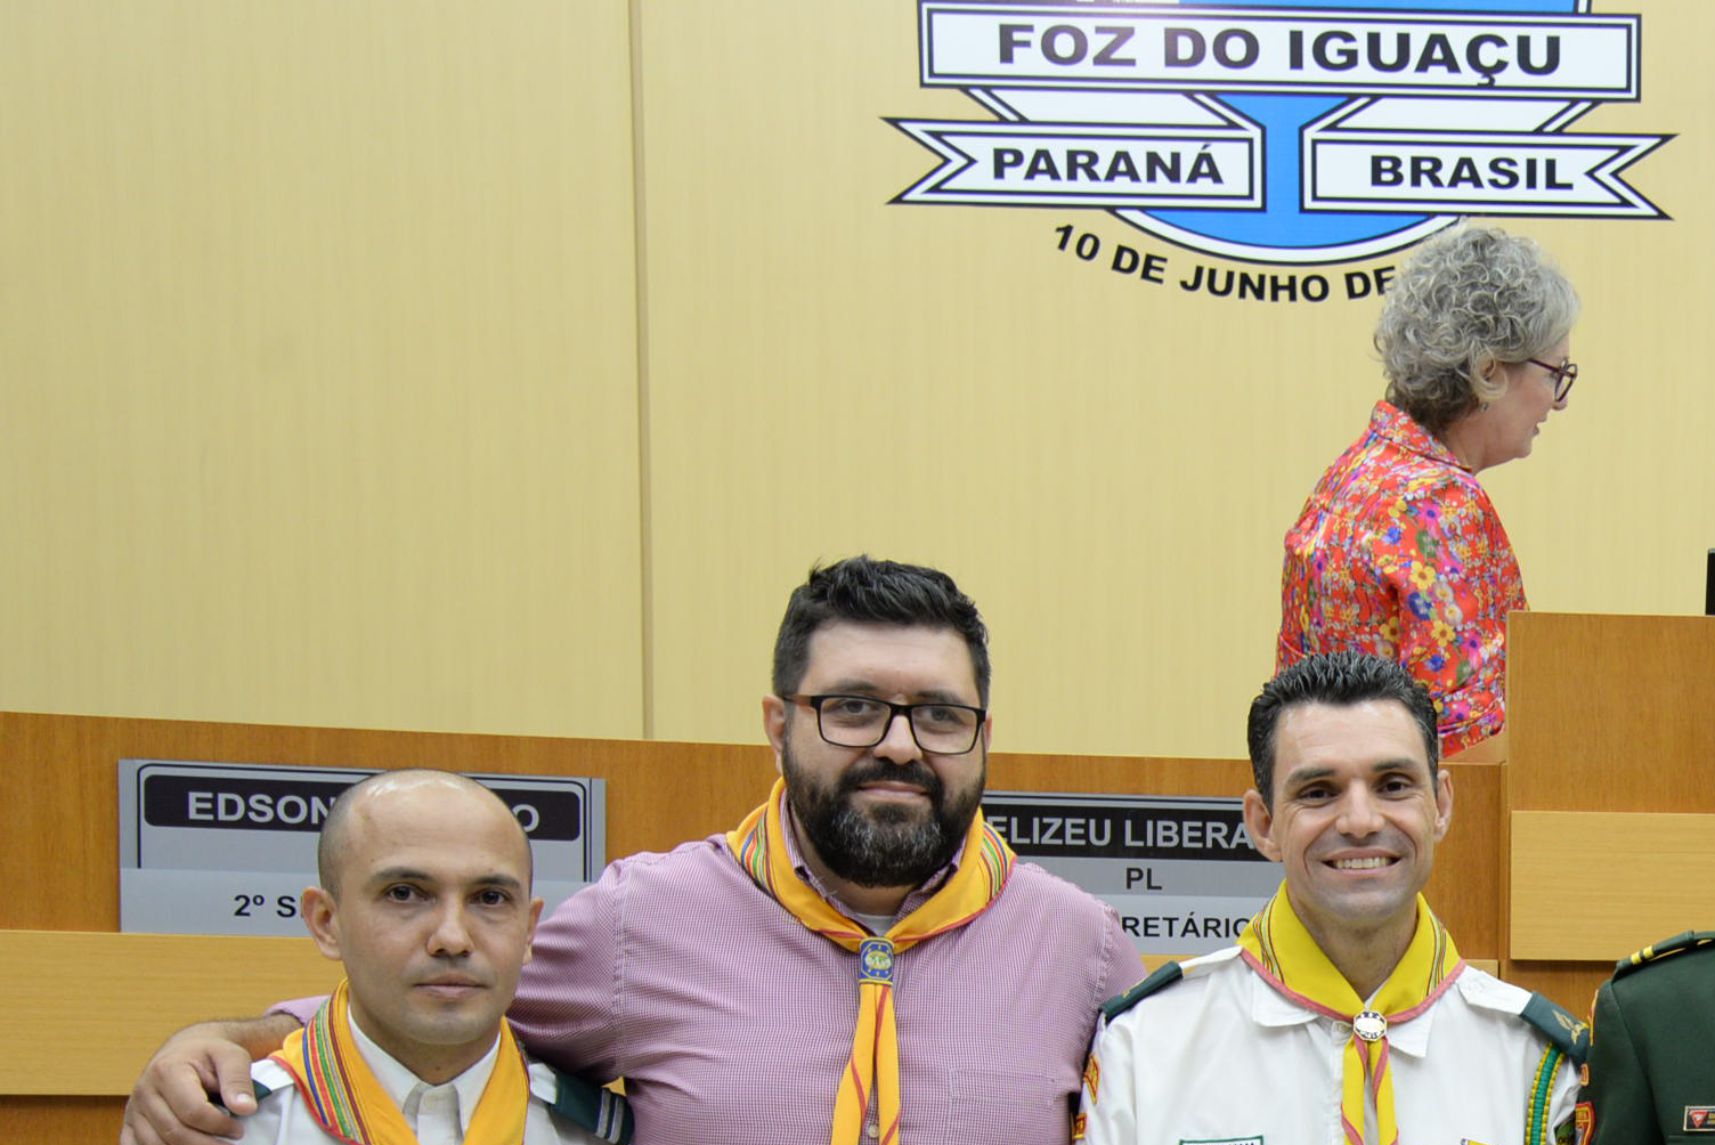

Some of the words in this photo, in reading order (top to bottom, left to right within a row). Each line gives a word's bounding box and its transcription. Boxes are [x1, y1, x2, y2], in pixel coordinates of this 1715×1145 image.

[998, 24, 1137, 67] FOZ
[1163, 28, 1260, 71] DO
[1290, 30, 1563, 87] IGUAÇU
[992, 145, 1224, 184] PARANÁ
[1370, 155, 1574, 190] BRASIL
[1054, 224, 1101, 261] 10
[1111, 245, 1168, 284] DE
[1180, 266, 1329, 302] JUNHO
[188, 791, 336, 824] EDSON
[987, 816, 1111, 846] ELIZEU
[1125, 819, 1254, 849] LIBERA
[1126, 867, 1162, 890] PL
[234, 894, 265, 917] 2º
[1122, 911, 1250, 938] RETÁRIO
